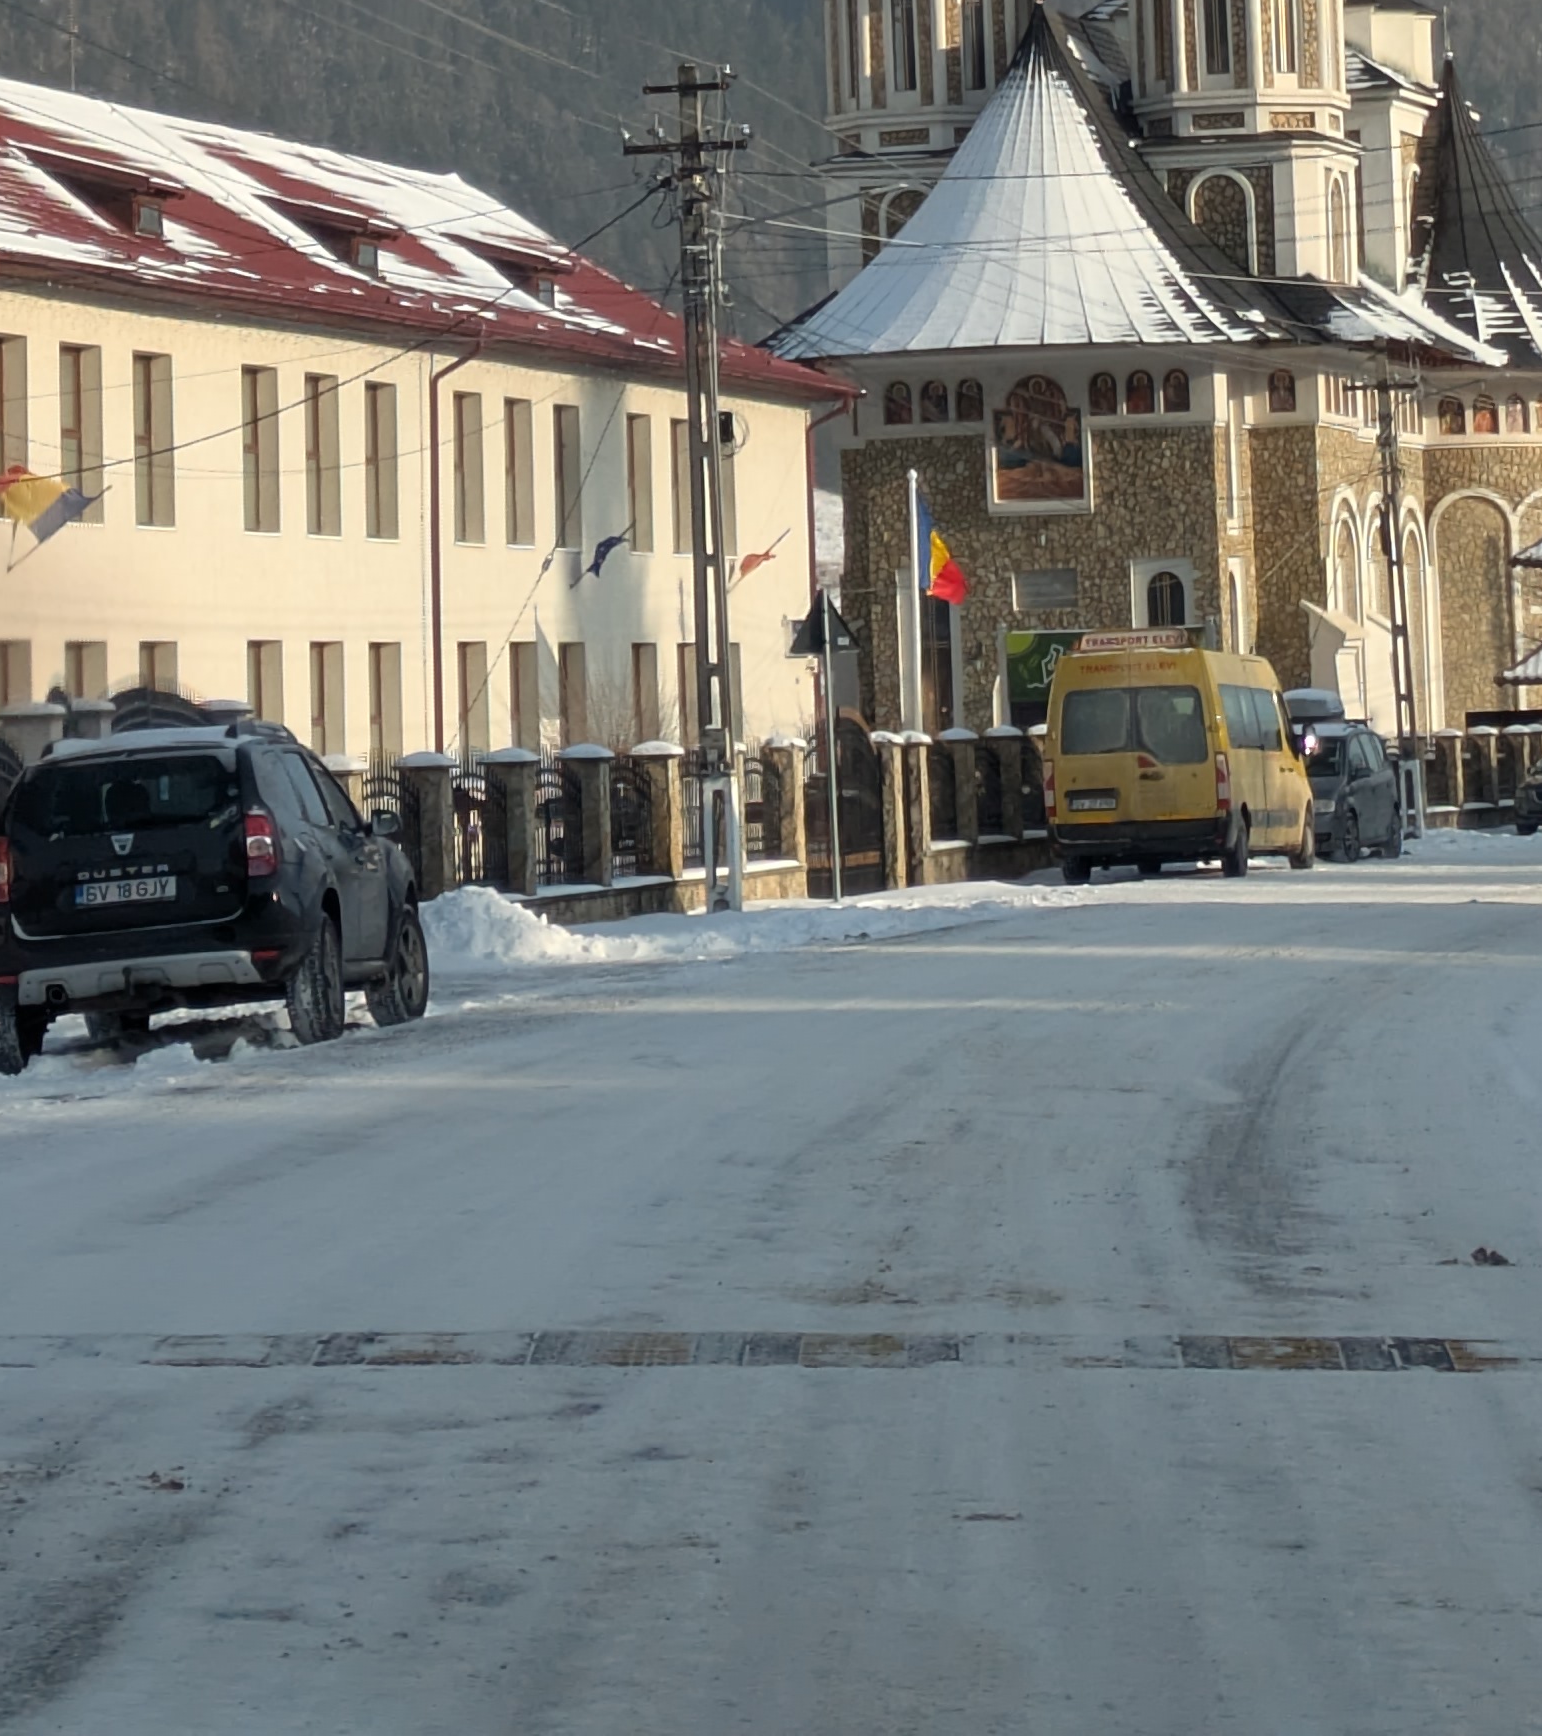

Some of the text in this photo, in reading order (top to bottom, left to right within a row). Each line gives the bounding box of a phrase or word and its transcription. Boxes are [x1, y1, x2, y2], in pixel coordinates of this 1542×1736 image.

[1085, 634, 1184, 647] TRANSPORT ELEVI
[117, 882, 132, 899] 18
[136, 879, 169, 897] GJY
